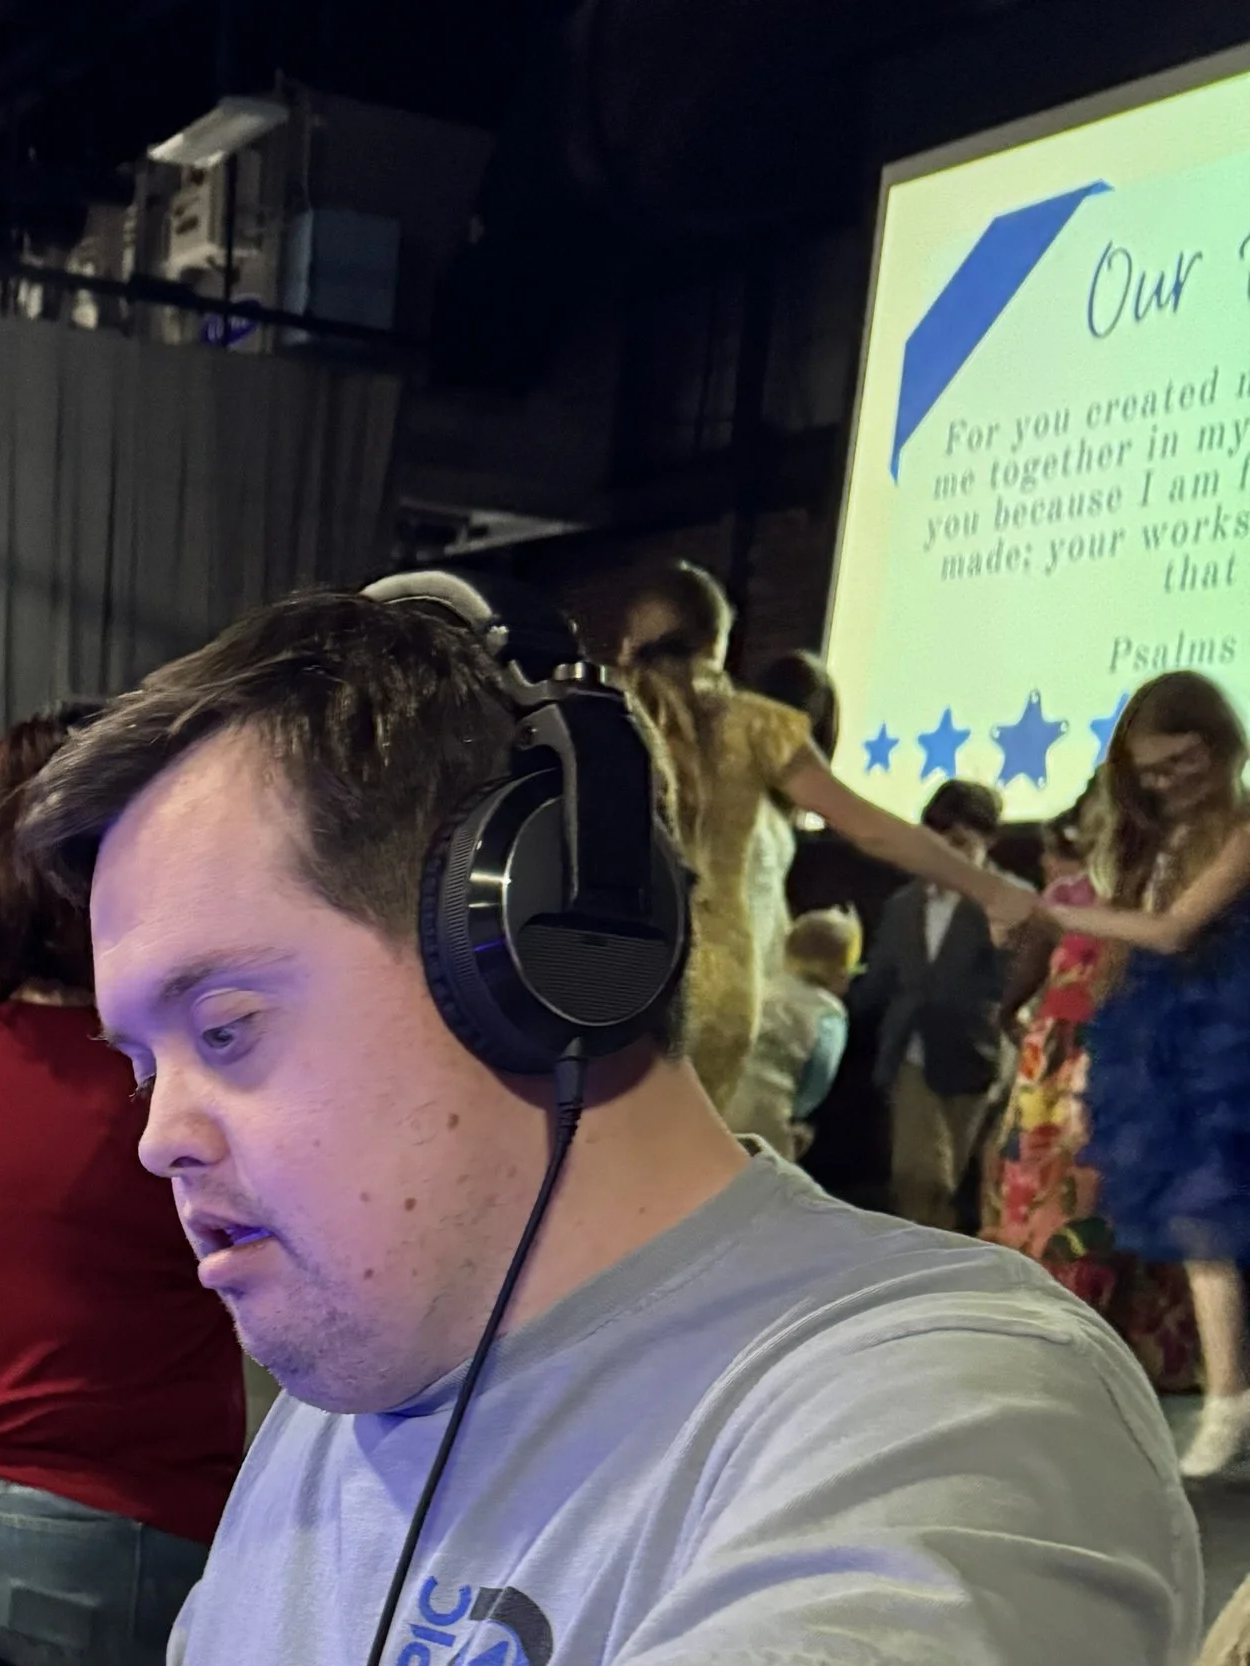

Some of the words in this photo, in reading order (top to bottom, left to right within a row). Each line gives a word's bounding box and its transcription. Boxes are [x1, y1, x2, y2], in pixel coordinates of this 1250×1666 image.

[1087, 239, 1203, 339] Our
[944, 418, 1001, 456] For
[1011, 406, 1071, 453] you
[1086, 364, 1219, 430] created
[933, 470, 975, 500] me
[990, 437, 1132, 494] together
[1147, 424, 1179, 462] in
[1197, 416, 1250, 458] my
[923, 510, 980, 552] you
[993, 495, 1123, 533] because
[1141, 468, 1154, 507] I
[1168, 469, 1220, 502] am
[1045, 527, 1126, 576] your
[1163, 553, 1237, 594] that
[1109, 629, 1238, 674] Psalms
